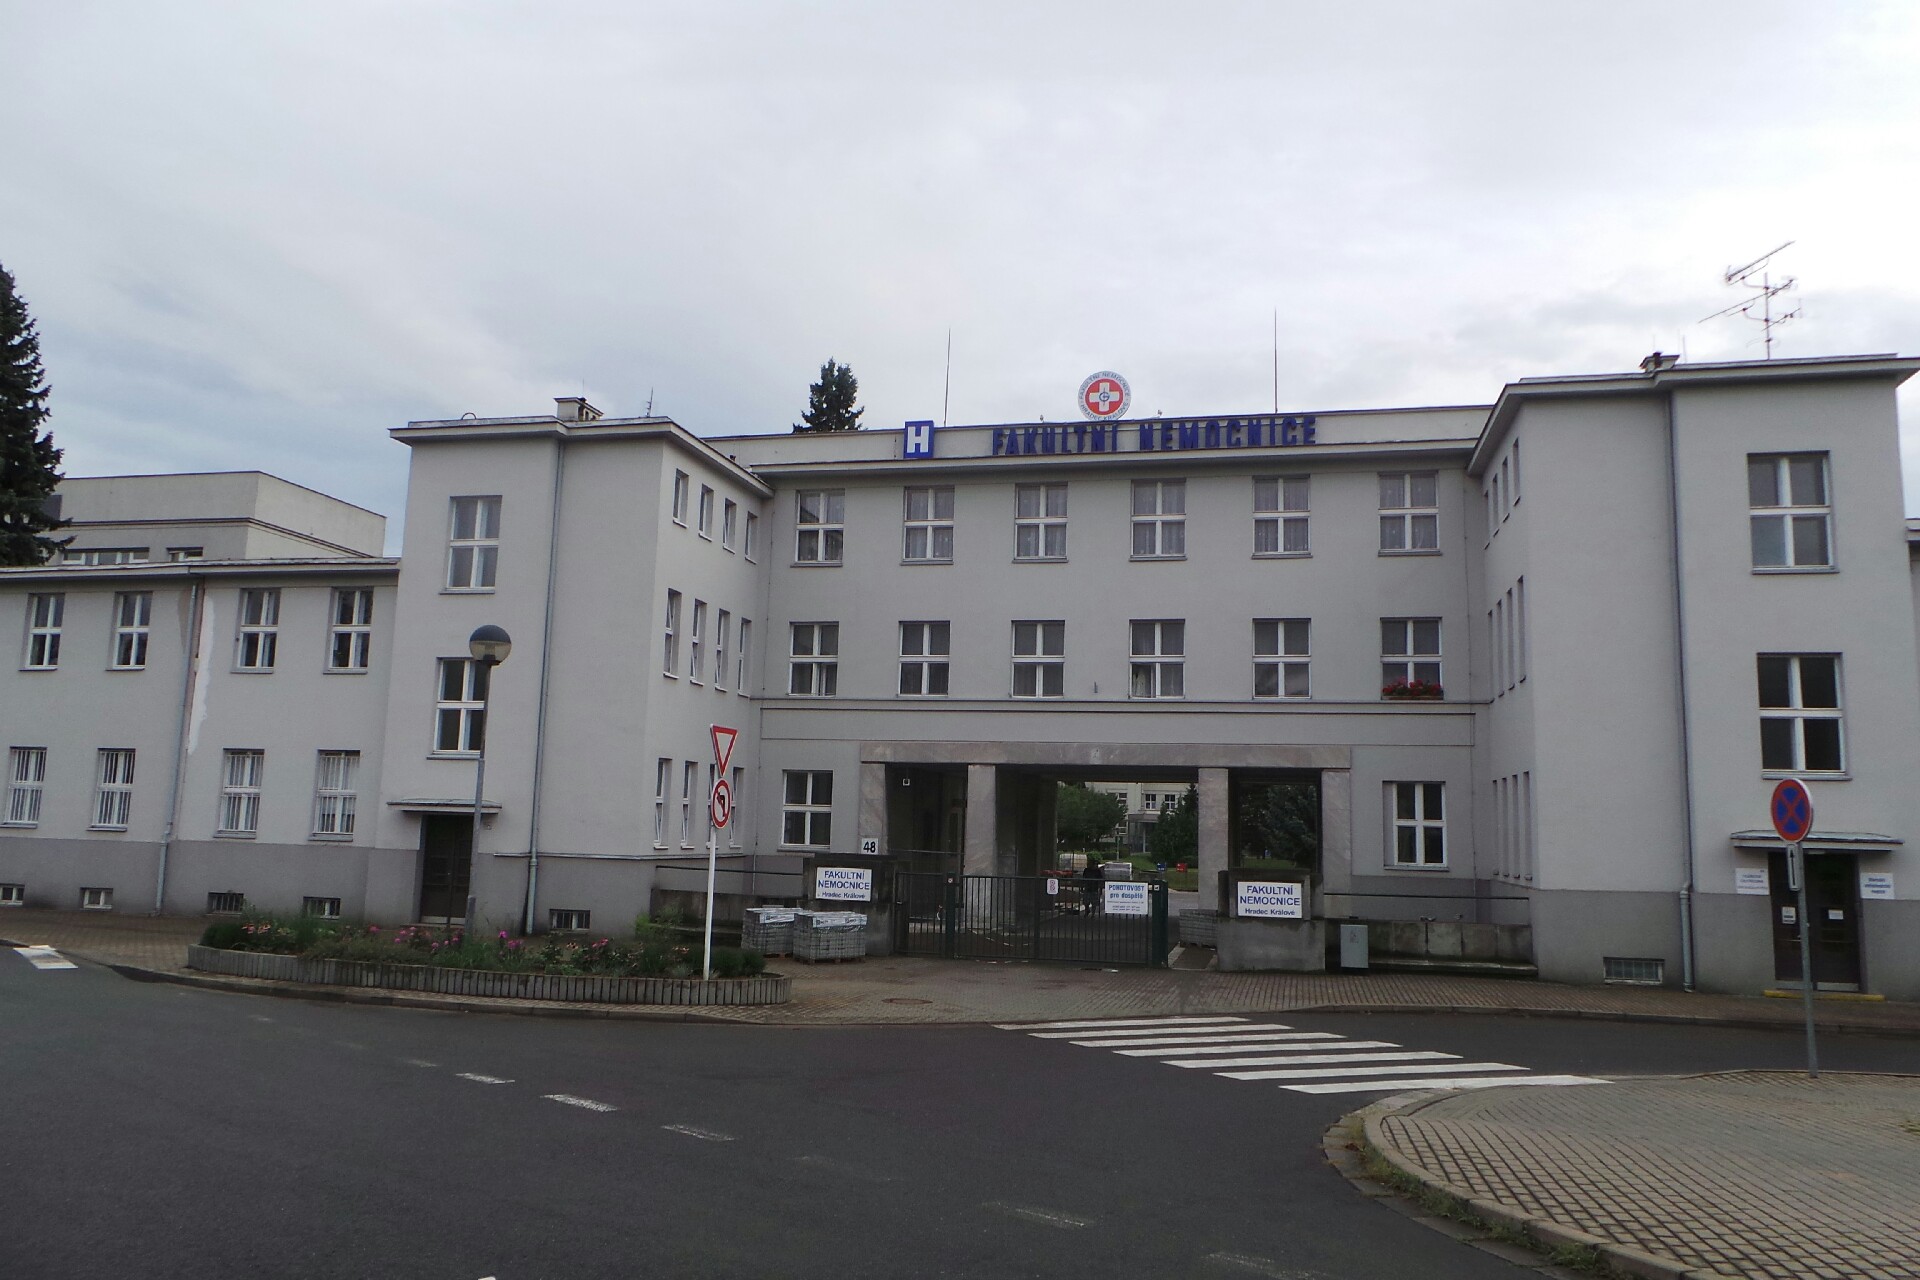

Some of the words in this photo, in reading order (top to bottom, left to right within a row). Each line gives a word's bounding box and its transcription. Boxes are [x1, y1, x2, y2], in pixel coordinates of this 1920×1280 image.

[1139, 415, 1317, 451] NEMOCNICE
[906, 425, 930, 454] H
[863, 841, 876, 853] 48
[824, 870, 865, 880] FAKULTNÍ
[818, 880, 870, 890] NEMOCNICE
[1246, 885, 1294, 895] FAKULTNÍ
[1240, 896, 1301, 906] NEMOCNICE
